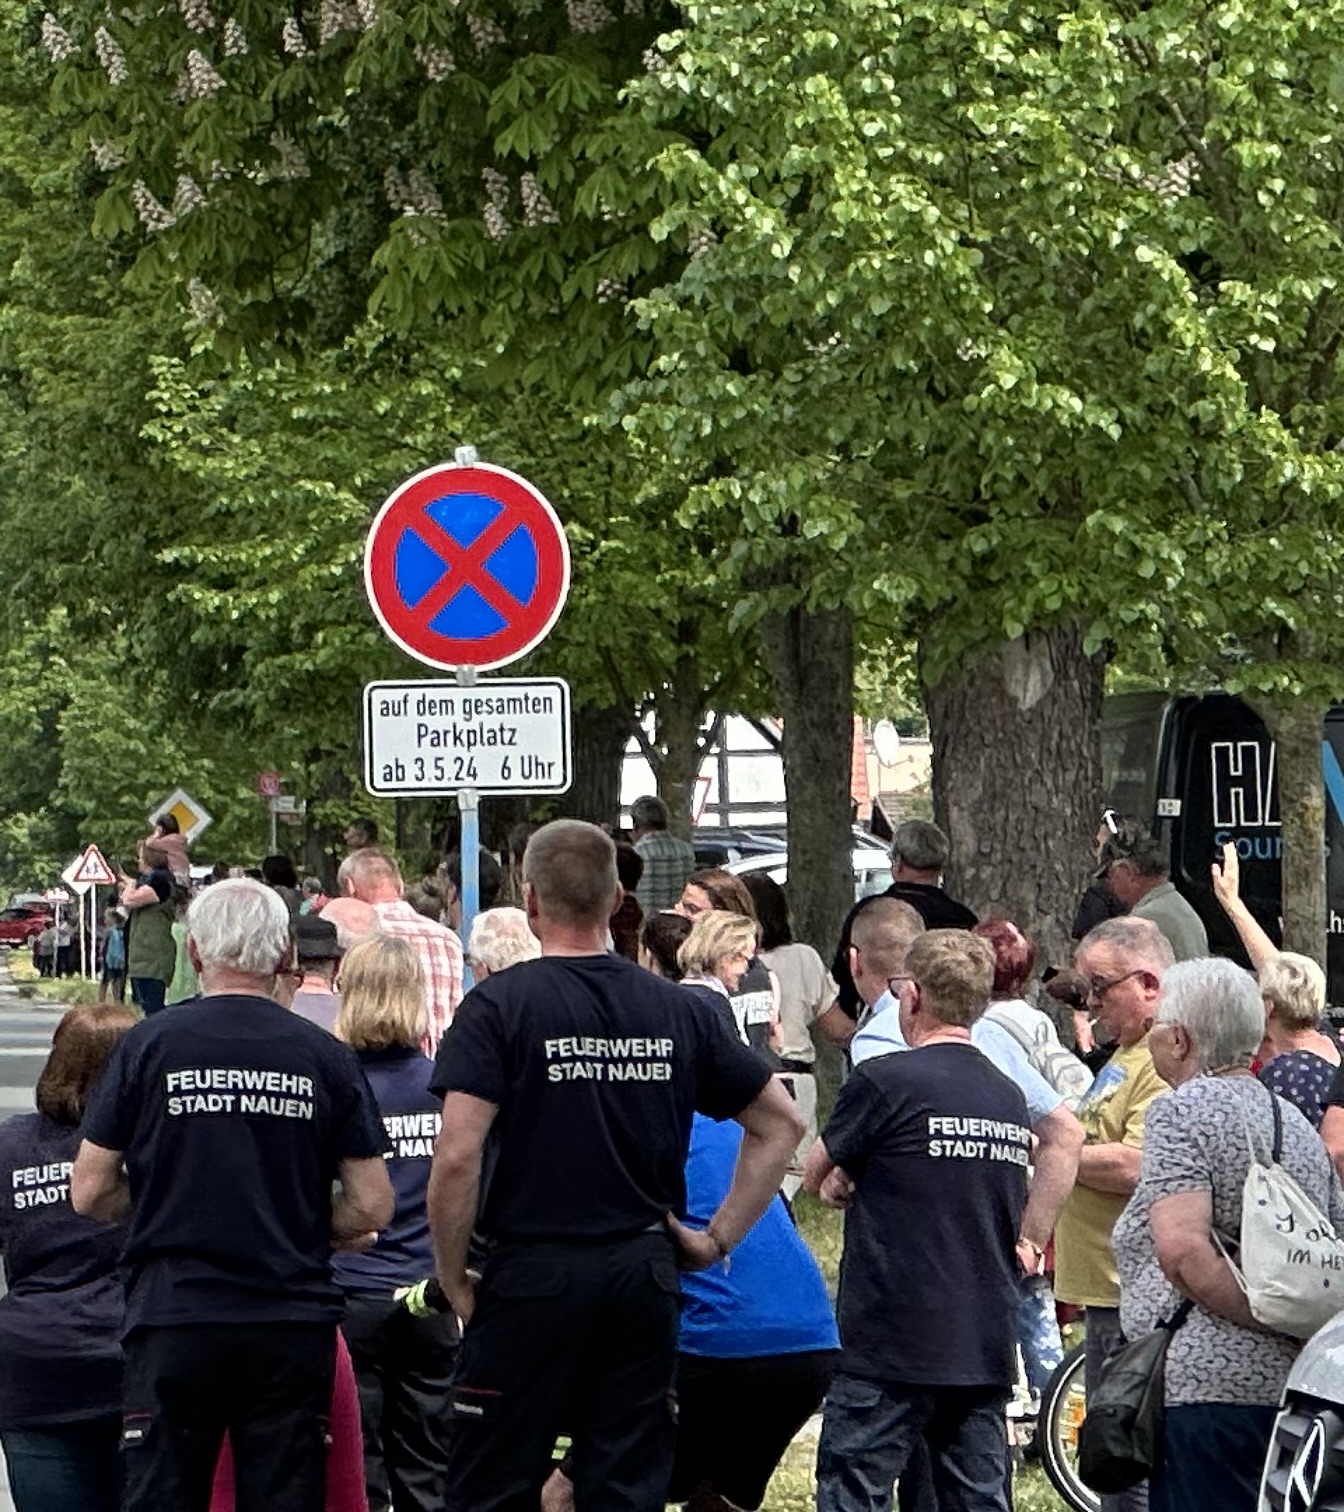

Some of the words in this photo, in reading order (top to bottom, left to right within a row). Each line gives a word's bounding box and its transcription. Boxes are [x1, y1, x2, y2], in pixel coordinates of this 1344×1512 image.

[380, 693, 409, 717] auf
[416, 693, 454, 716] dem
[462, 692, 553, 721] gesamten
[416, 722, 518, 752] Parkplatz
[382, 758, 406, 782] ab
[414, 757, 479, 782] 3.5.24
[501, 756, 511, 780] 6
[520, 755, 556, 780] Uhr
[545, 1037, 673, 1059] FEUERWEHR
[166, 1069, 313, 1097] FEUERWEHR
[168, 1094, 236, 1116] STADT
[240, 1095, 313, 1120] NAUEN
[928, 1140, 988, 1159] STADT
[14, 1185, 70, 1209] STADT
